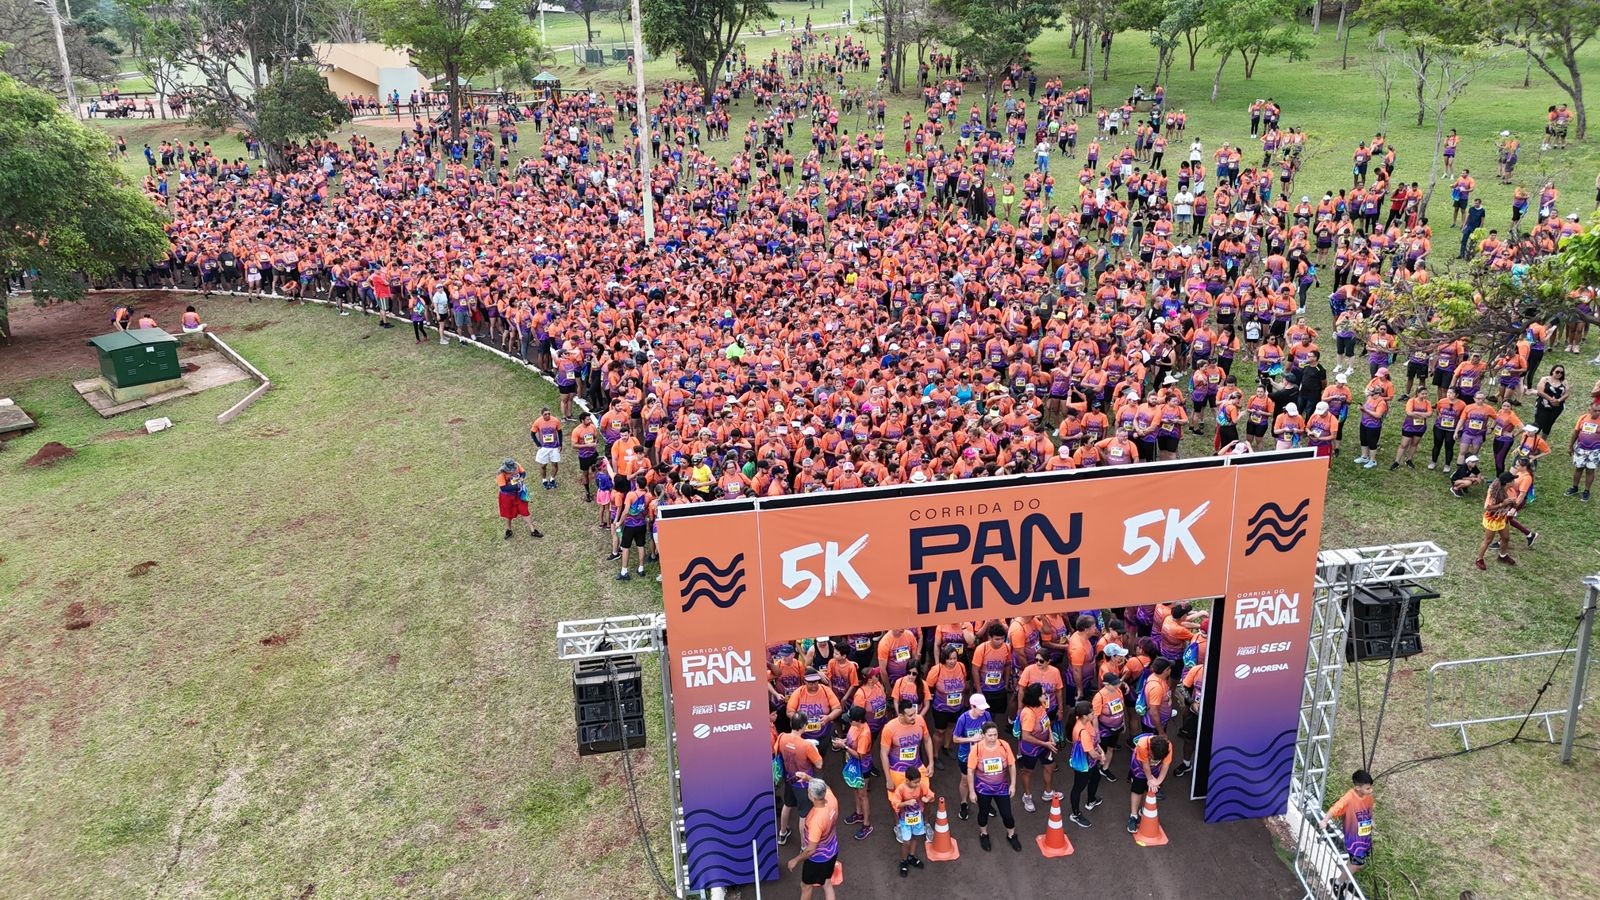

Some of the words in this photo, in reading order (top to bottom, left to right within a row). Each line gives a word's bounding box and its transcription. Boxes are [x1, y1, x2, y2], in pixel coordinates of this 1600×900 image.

[909, 502, 1002, 521] CORRIDA
[1014, 498, 1041, 511] DO
[909, 512, 1083, 571] PAN
[1117, 500, 1210, 575] 5K
[778, 533, 871, 610] 5K
[908, 557, 1090, 614] TANAL
[1237, 590, 1271, 598] CORRIDA
[1235, 593, 1300, 615] PAN
[1234, 608, 1300, 630] TANAL
[681, 647, 719, 656] CORRIDA
[1260, 641, 1291, 653] SESI
[681, 650, 751, 673] PAN
[1252, 662, 1289, 673] MORENA
[682, 666, 756, 688] TANAL
[718, 700, 751, 712] SESI
[713, 722, 753, 733] MORENA
